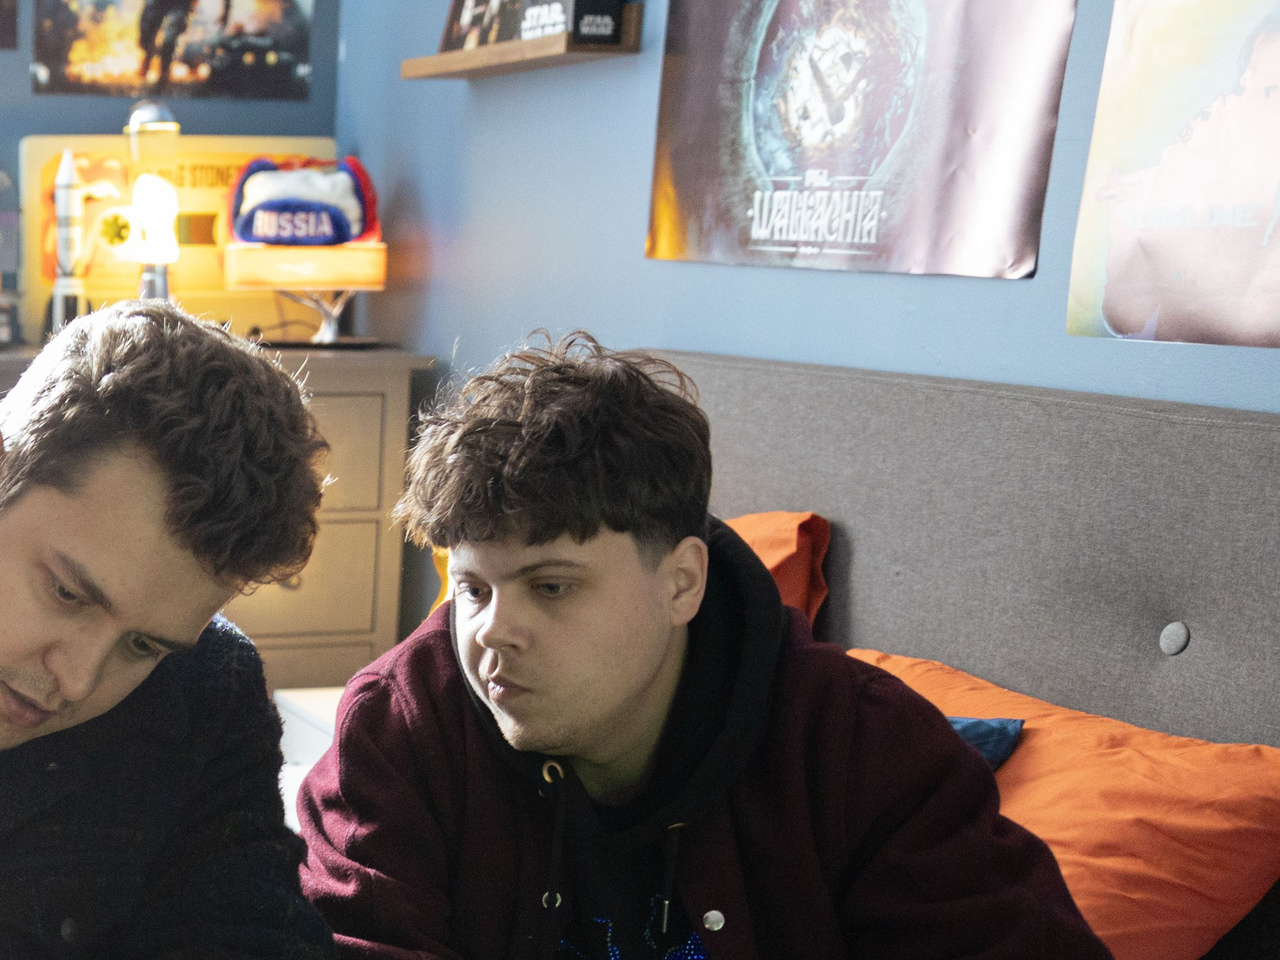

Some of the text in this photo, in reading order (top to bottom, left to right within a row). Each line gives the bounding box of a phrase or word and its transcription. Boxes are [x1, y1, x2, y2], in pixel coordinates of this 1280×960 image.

[521, 2, 566, 29] STAR
[251, 209, 334, 238] RUSSIA
[750, 190, 884, 244] WALLACHIA
